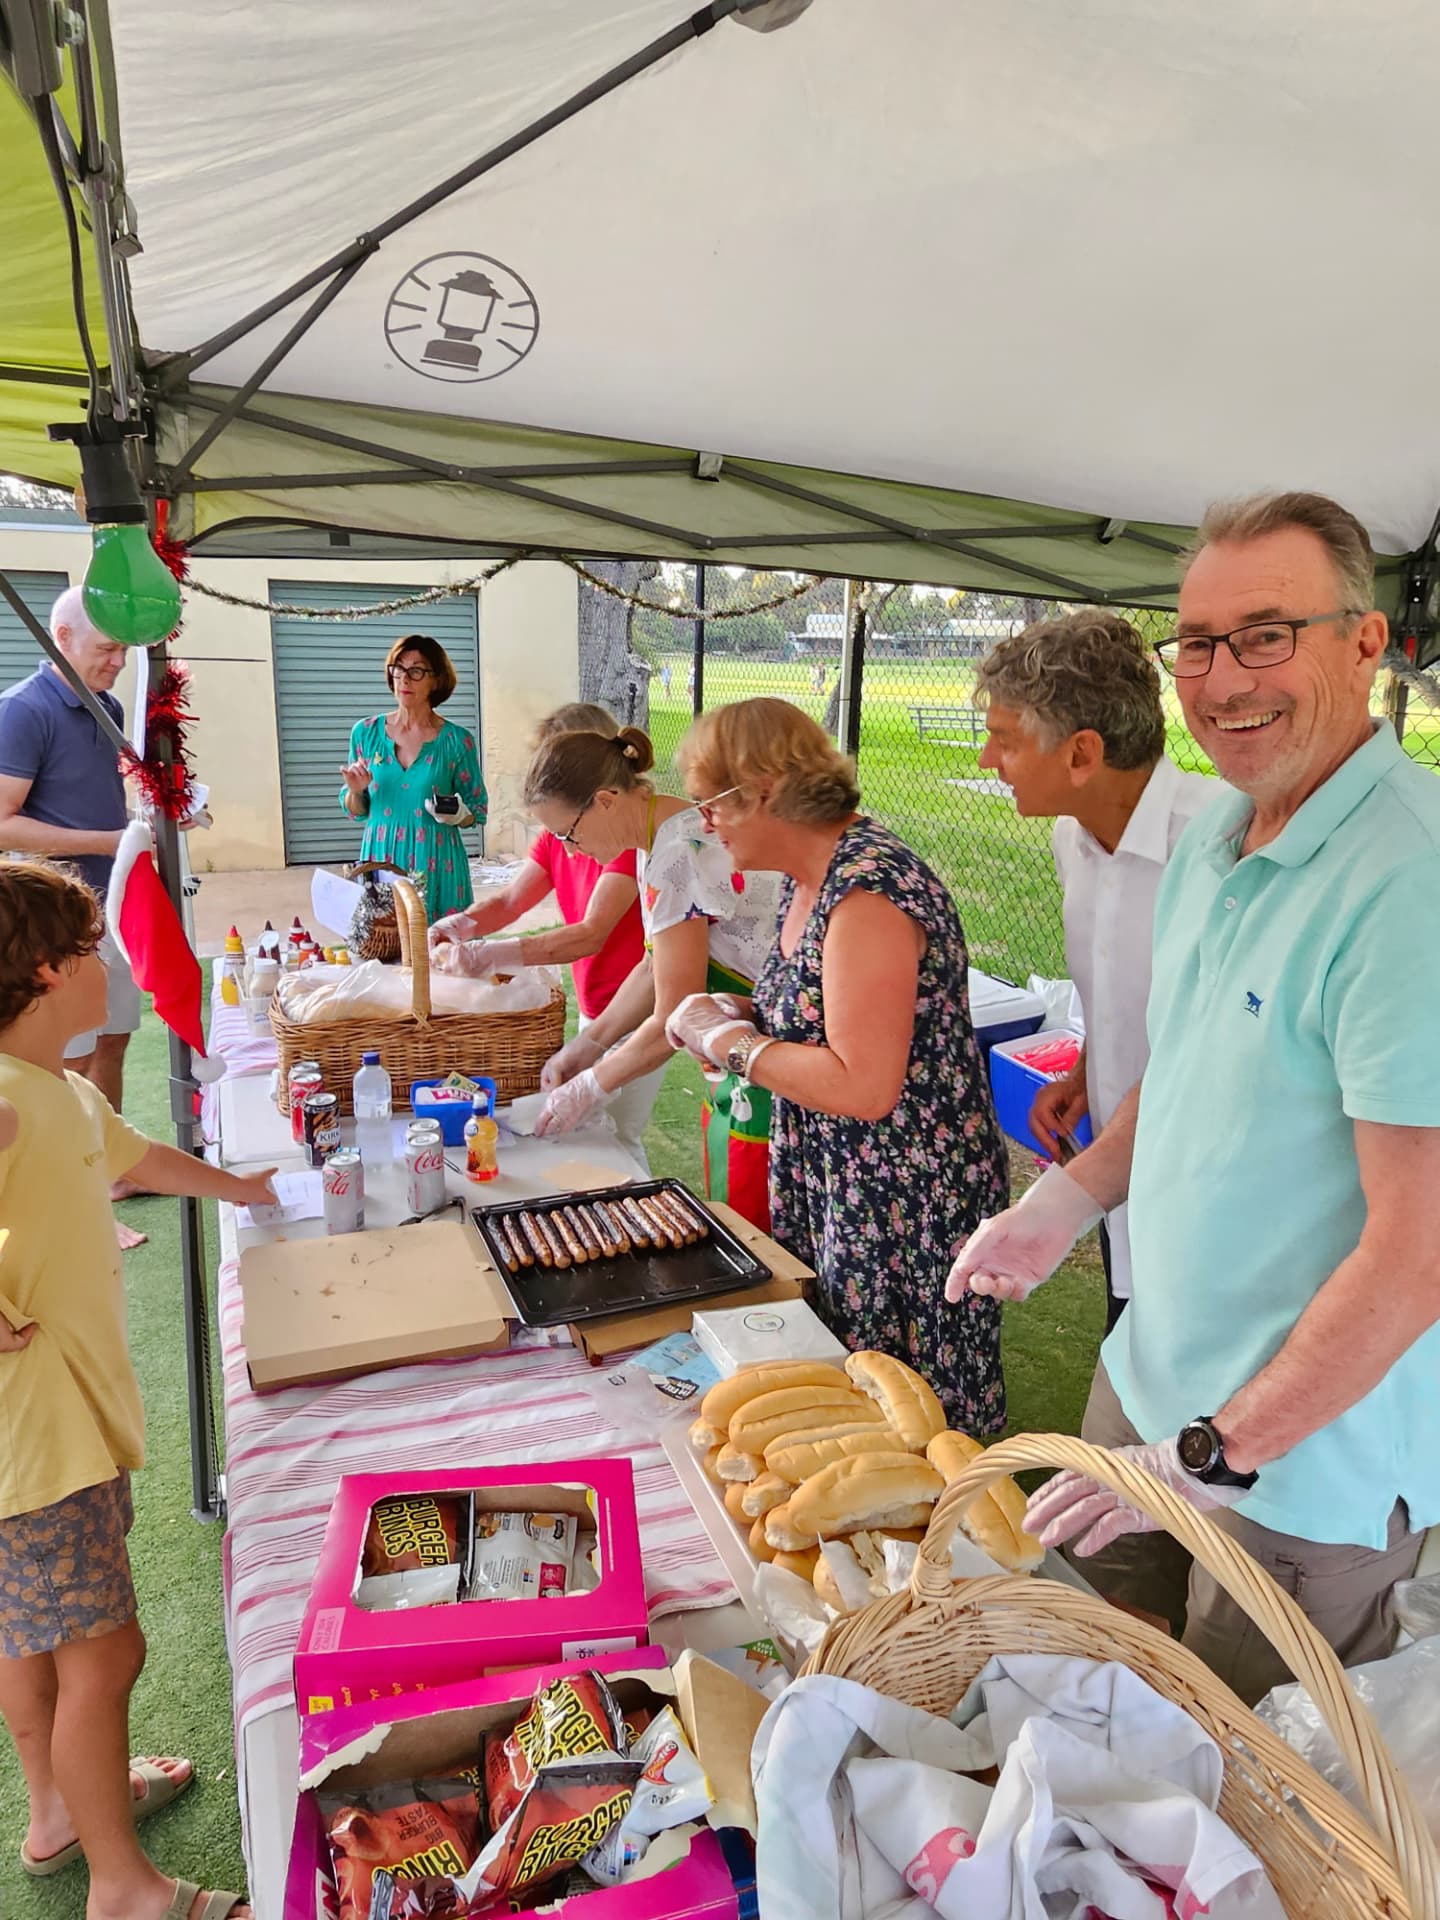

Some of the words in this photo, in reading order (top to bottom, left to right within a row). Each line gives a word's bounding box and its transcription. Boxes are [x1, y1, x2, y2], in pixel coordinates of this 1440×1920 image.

[323, 1168, 350, 1196] ola
[375, 1502, 417, 1558] RINGS
[405, 1498, 450, 1567] BURGER
[396, 1804, 427, 1827] TASTE
[400, 1814, 438, 1841] BURGER
[426, 1830, 444, 1843] BIG
[513, 1841, 590, 1888] RING
